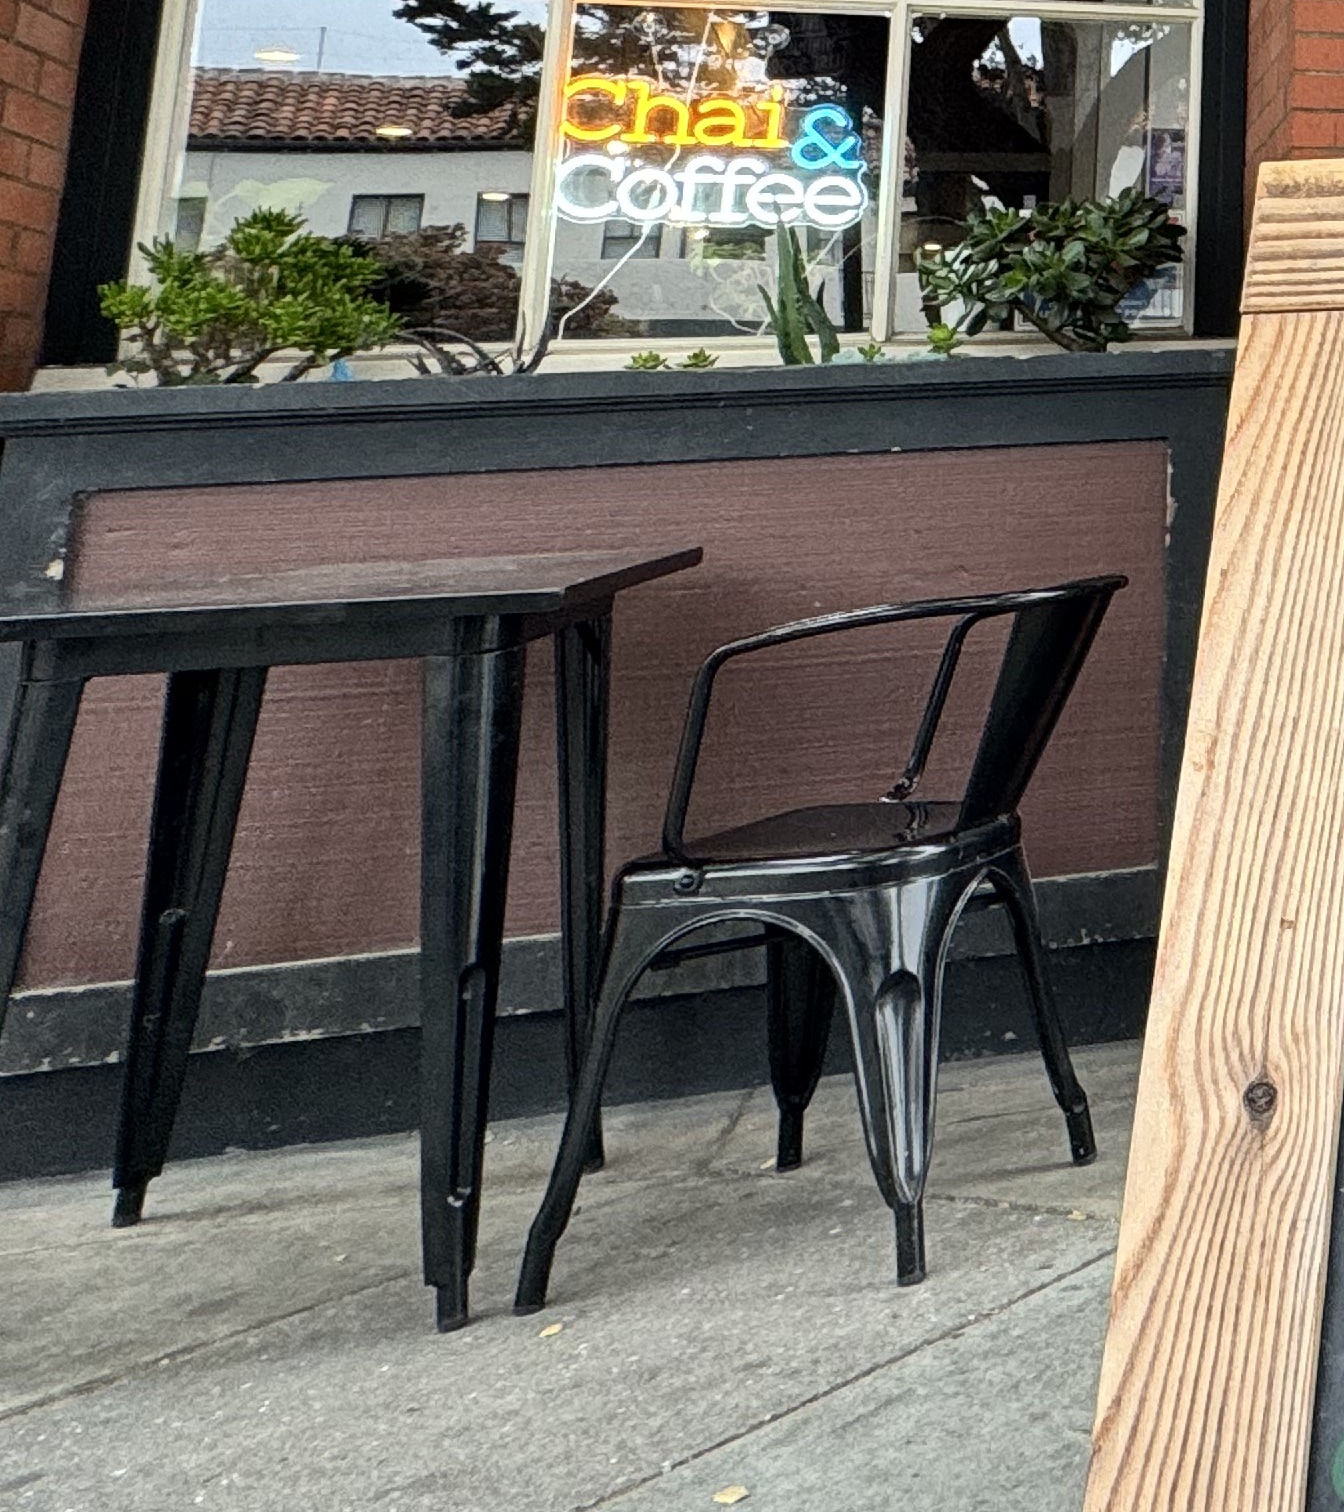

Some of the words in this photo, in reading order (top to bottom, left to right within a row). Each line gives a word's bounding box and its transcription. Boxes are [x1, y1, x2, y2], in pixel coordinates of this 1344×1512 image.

[562, 76, 790, 149] Chai
[791, 103, 863, 171] &
[554, 156, 866, 226] Coffee
